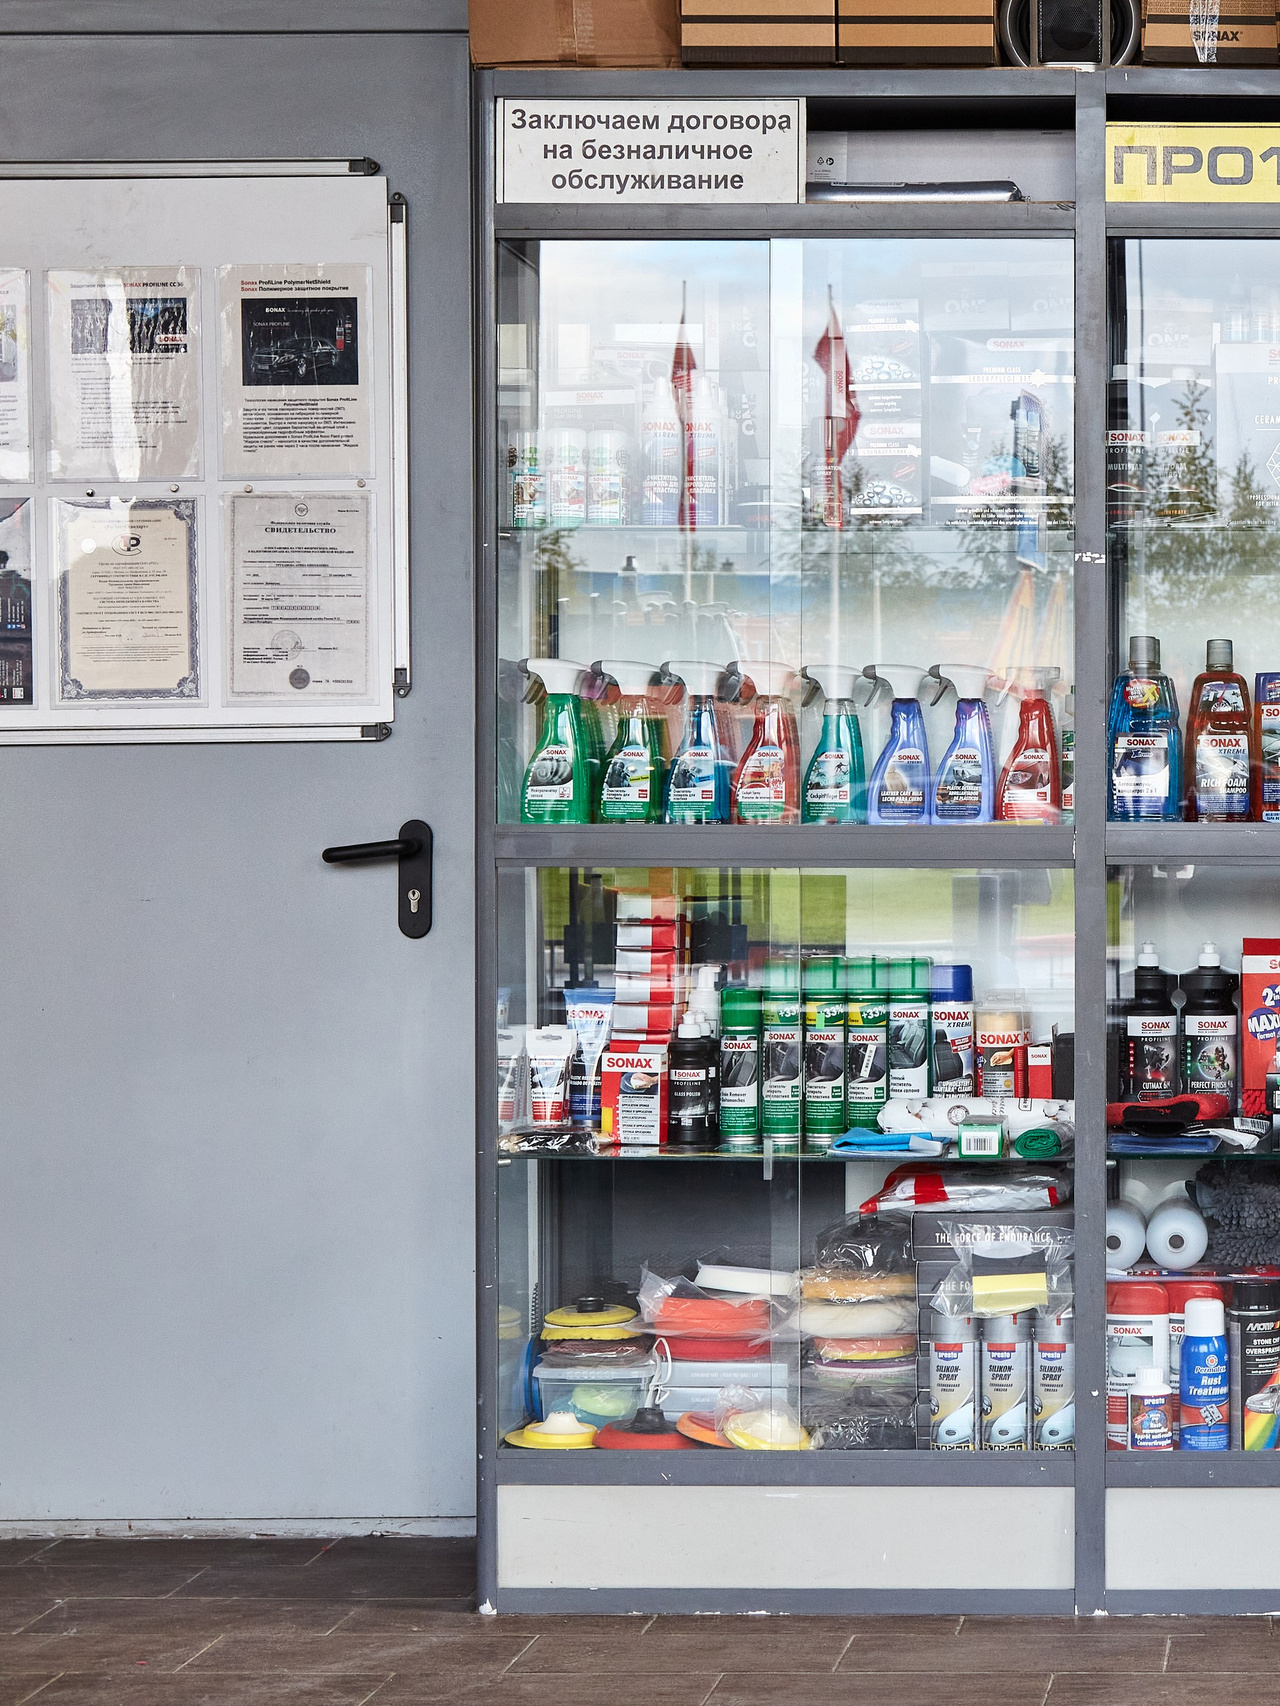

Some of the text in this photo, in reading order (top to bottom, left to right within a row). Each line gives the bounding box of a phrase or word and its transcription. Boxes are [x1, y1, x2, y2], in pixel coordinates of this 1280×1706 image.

[511, 109, 792, 135] Заключаем договора
[543, 139, 752, 160] на безналичное
[551, 169, 744, 192] обслуживание
[1110, 433, 1144, 442] SONAX
[264, 526, 337, 534] СВИДЕТЕЛЬСТВО
[1126, 738, 1156, 746] SONAX
[1202, 738, 1241, 748] SONAX
[569, 1010, 605, 1019] SONAX
[933, 1011, 969, 1021] SONAX
[1141, 1021, 1171, 1029] SONAX
[1197, 1021, 1228, 1029] SONAX
[809, 1033, 836, 1041] SONAX
[851, 1034, 879, 1042] SONAX
[980, 1034, 1021, 1044] SONAX
[723, 1042, 752, 1050] SONAX
[606, 1057, 653, 1069] SONAX
[1191, 1081, 1210, 1089] PERFECT
[935, 1232, 952, 1243] THE
[985, 1233, 996, 1243] OF
[999, 1231, 1051, 1243] ENDURANCE
[1113, 1327, 1143, 1335] SONAX
[1253, 1338, 1272, 1346] STONE
[1201, 1375, 1222, 1385] Rust
[1188, 1385, 1229, 1396] Treatmen
